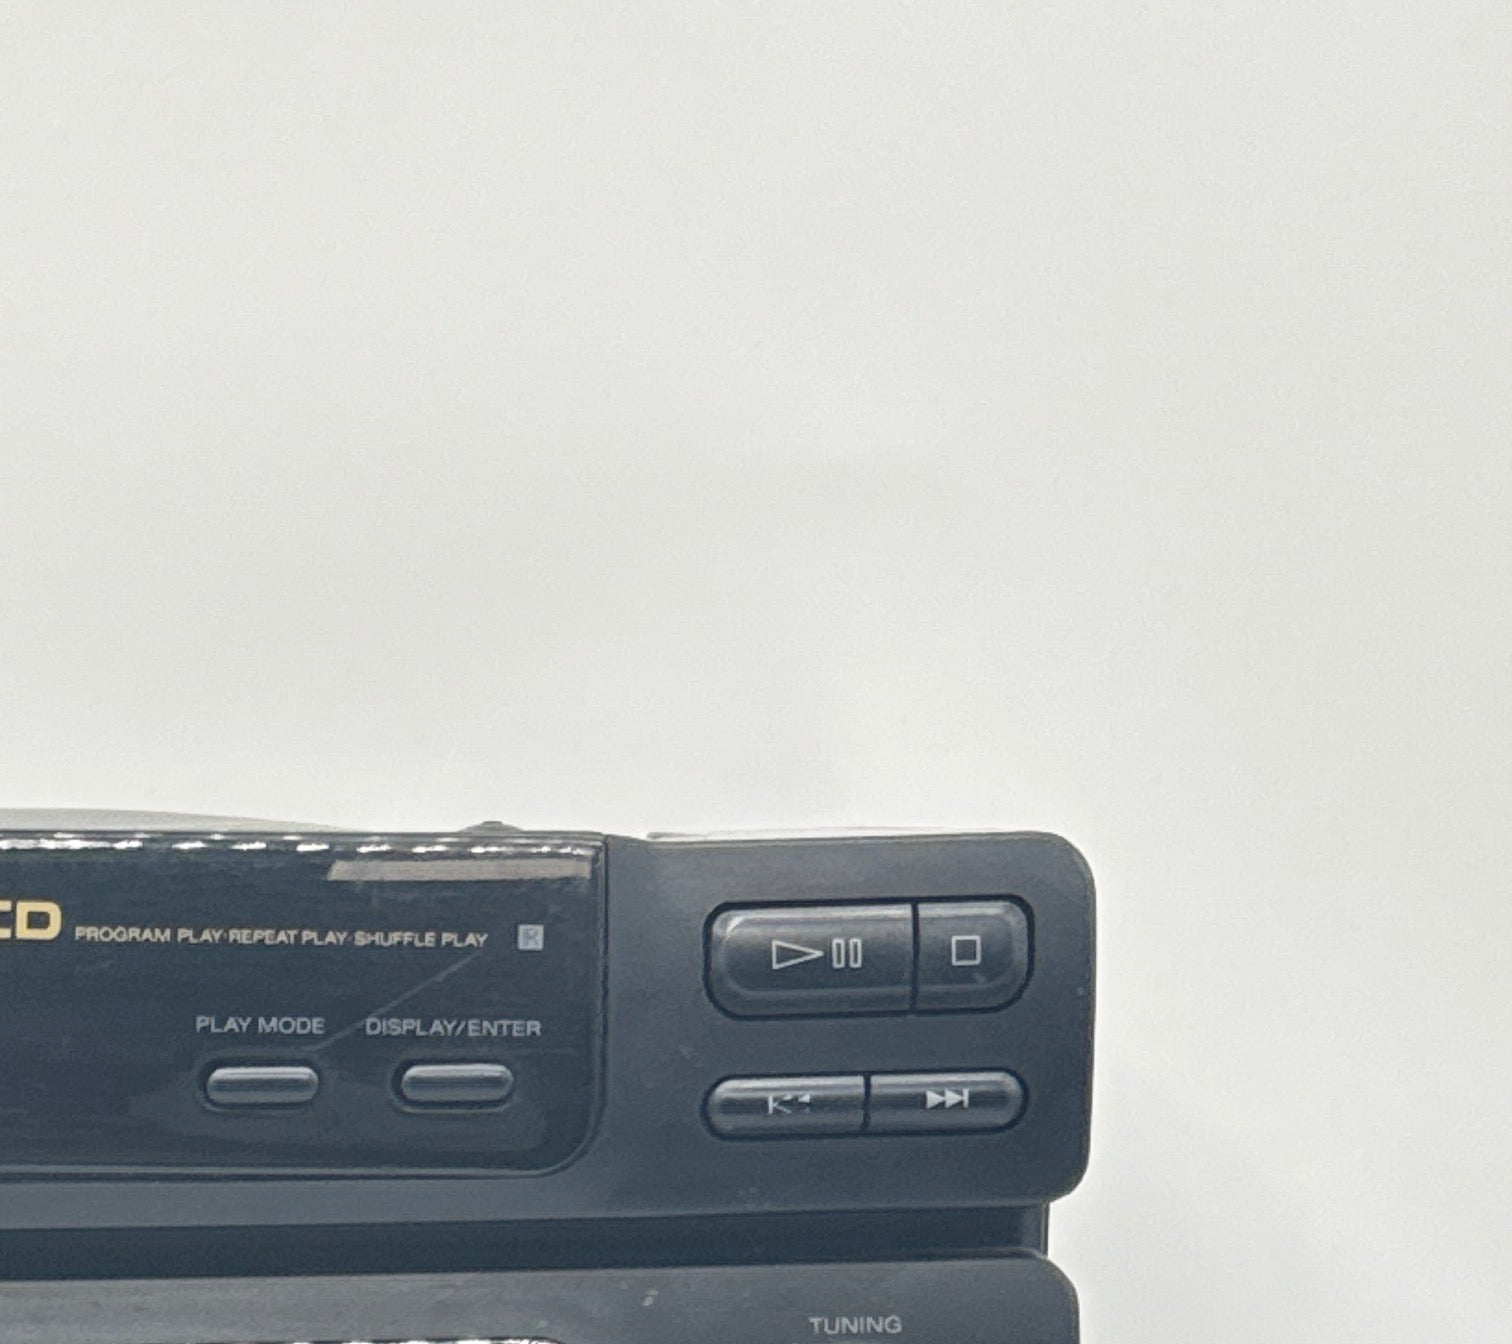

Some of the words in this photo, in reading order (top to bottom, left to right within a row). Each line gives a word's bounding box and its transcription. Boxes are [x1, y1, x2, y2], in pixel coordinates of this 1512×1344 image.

[75, 925, 170, 943] PROGRAM
[441, 932, 488, 949] PLAY
[195, 1016, 251, 1034] PLAY
[258, 1016, 326, 1035] MODE
[365, 1018, 542, 1037] DISPLAY/ENTER
[808, 1316, 903, 1335] TUNING
